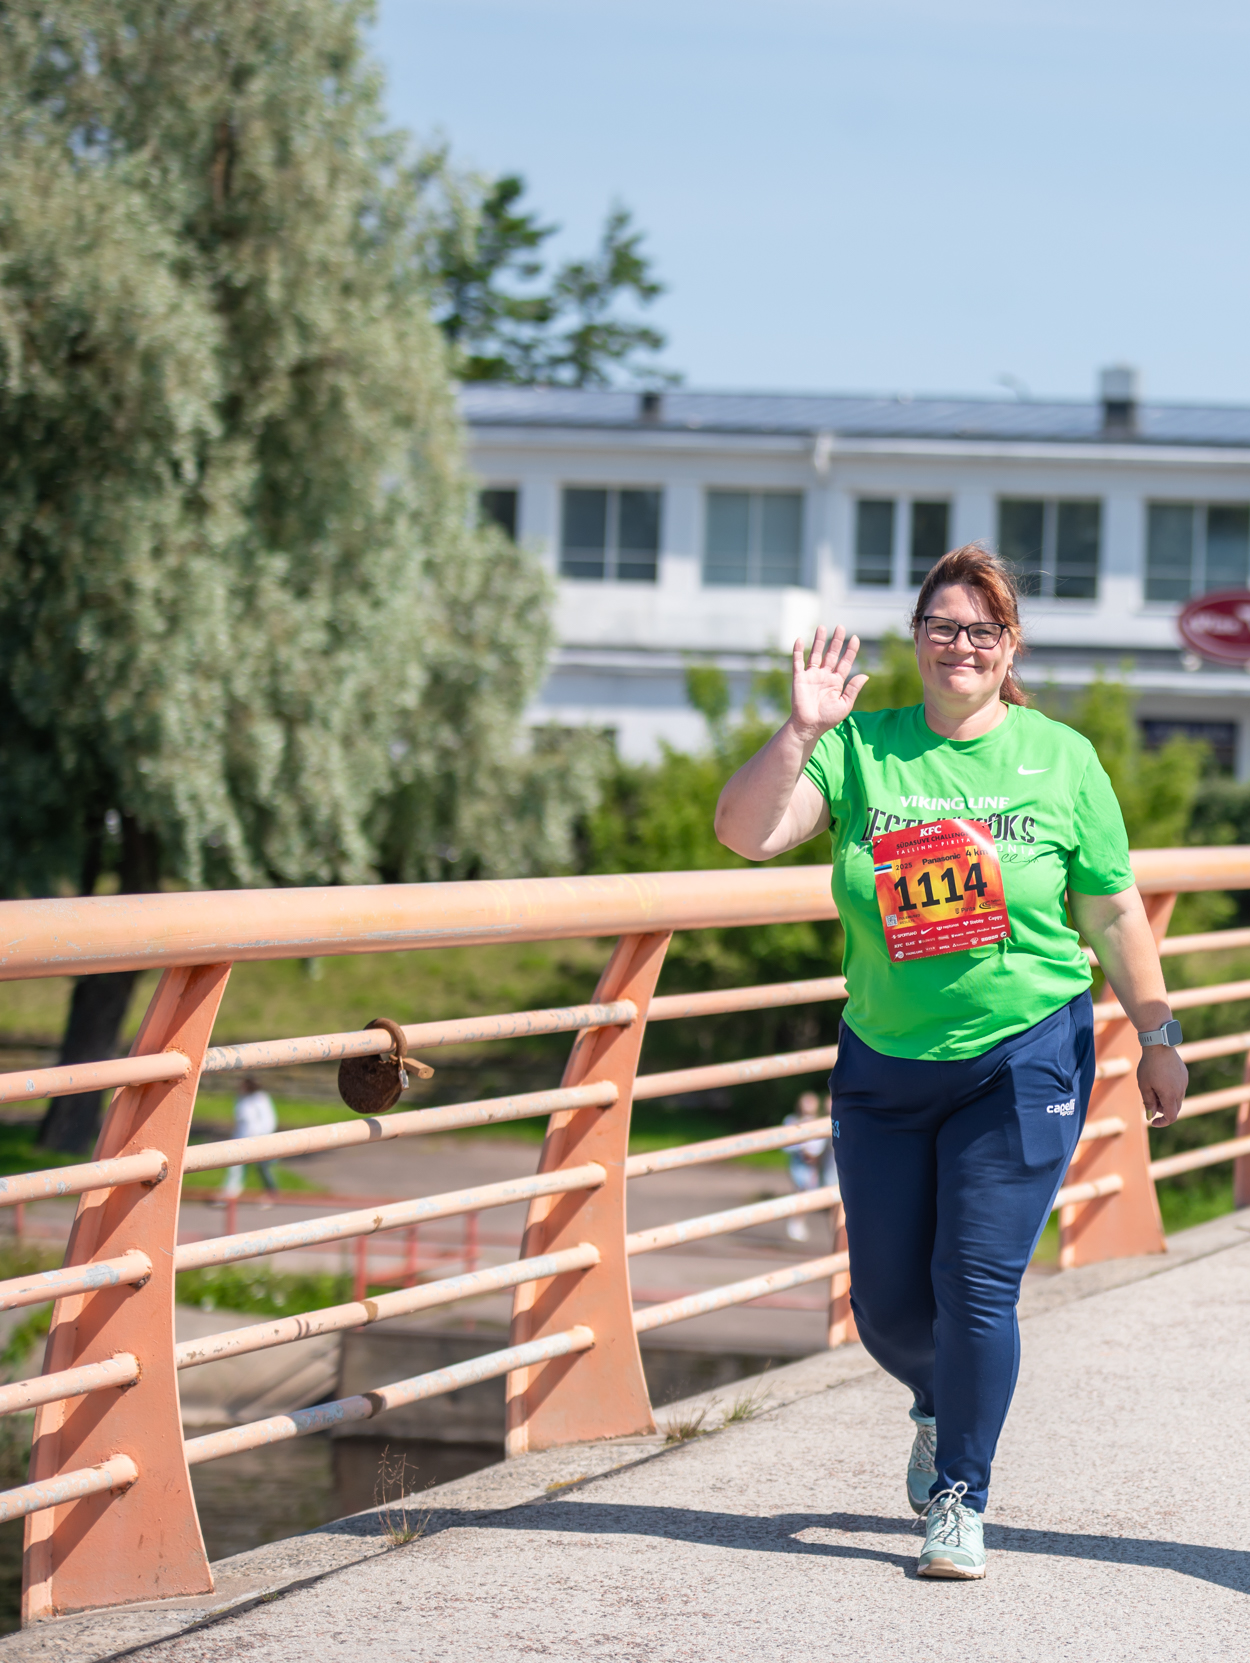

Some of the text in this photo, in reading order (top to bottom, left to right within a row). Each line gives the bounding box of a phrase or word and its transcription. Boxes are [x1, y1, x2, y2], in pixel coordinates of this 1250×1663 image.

[900, 795, 1009, 811] VIKING LINE
[919, 825, 942, 837] KFC
[896, 837, 930, 850] SÜDASUVE
[896, 844, 932, 855] TALLINN
[941, 838, 971, 846] PIRITA
[895, 848, 989, 871] 2025 Panasonic 4 km
[894, 862, 988, 912] 1114
[1046, 1099, 1076, 1115] capelli
